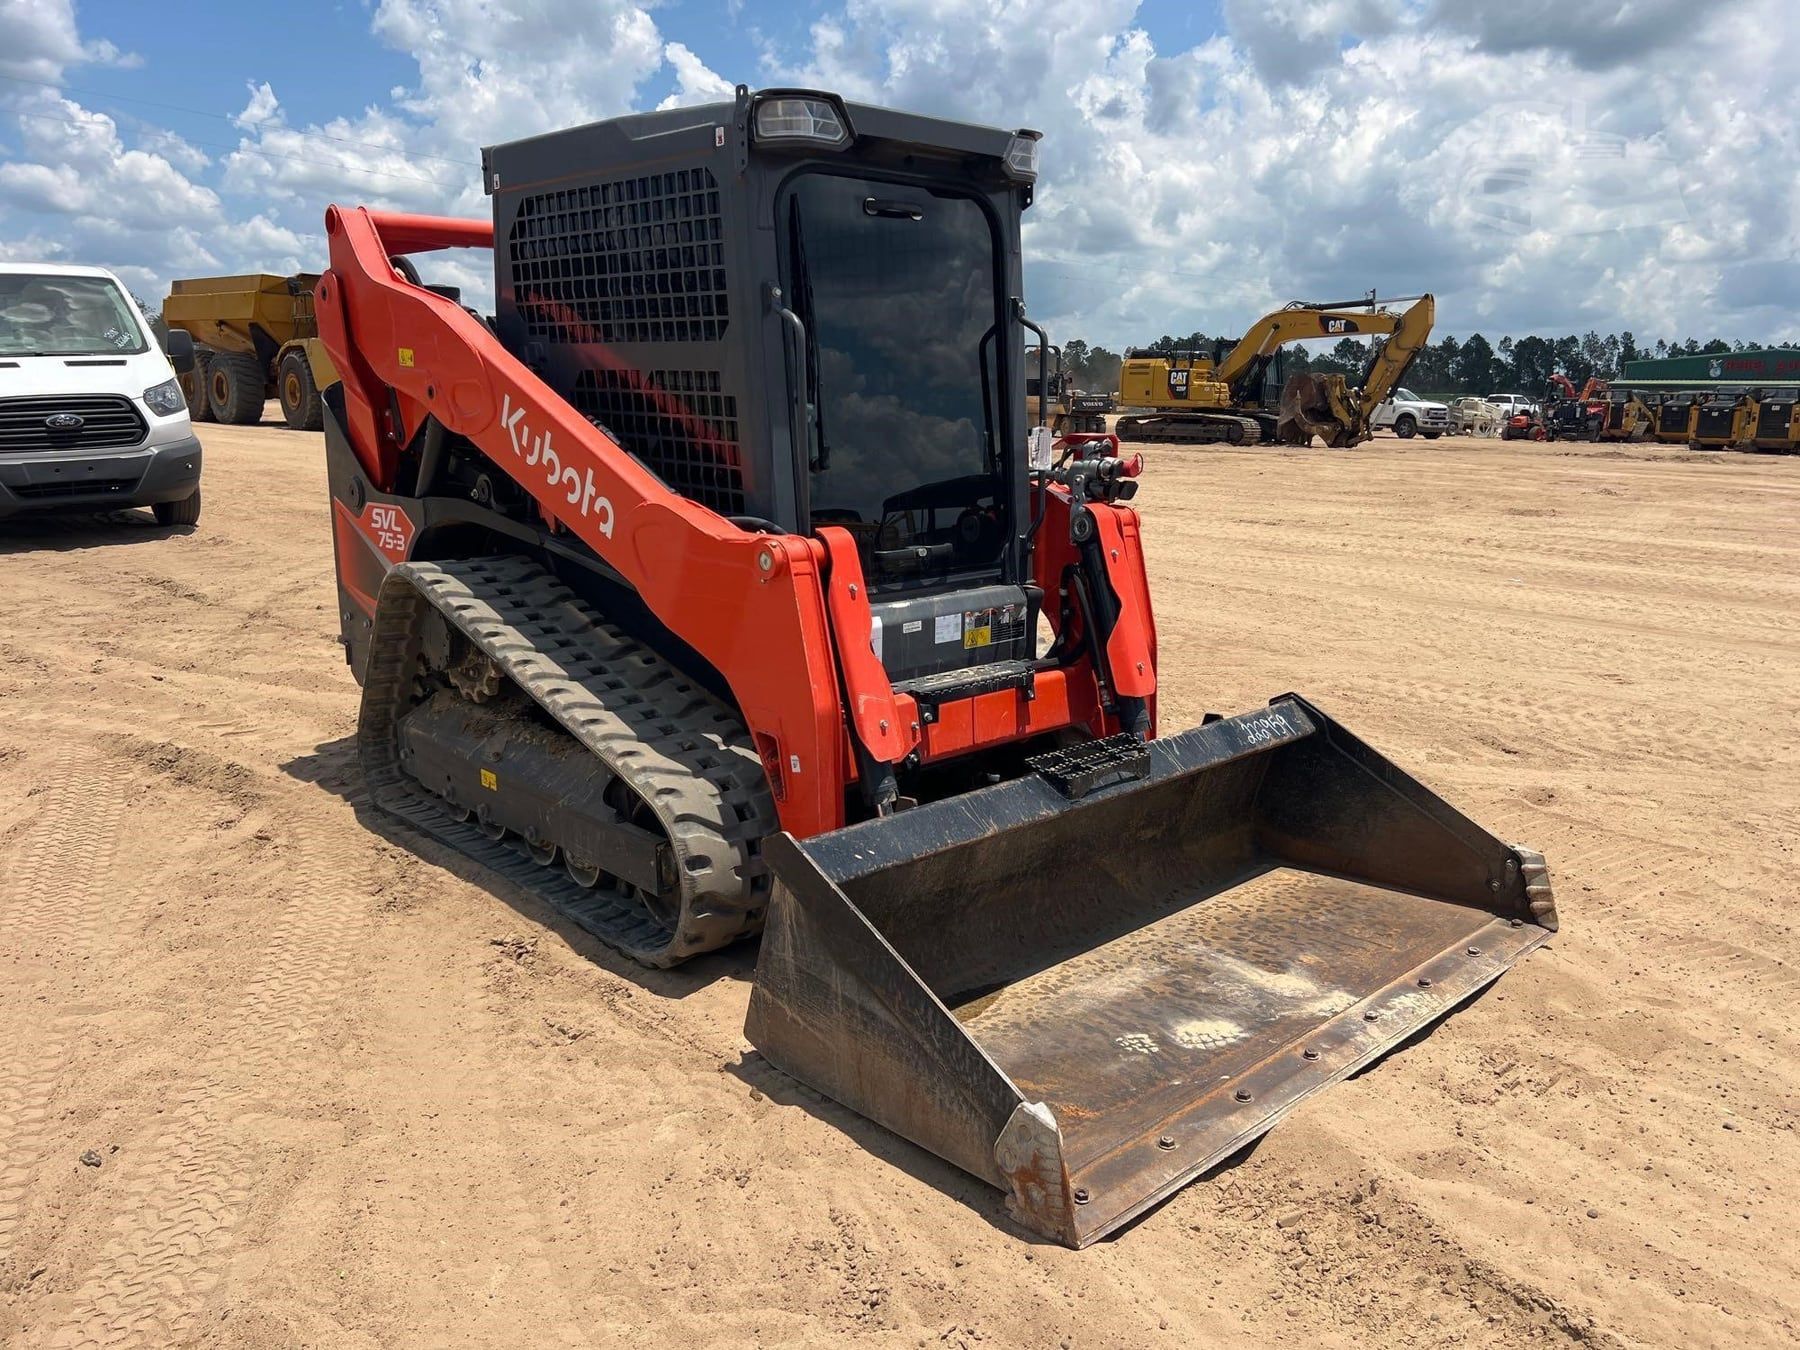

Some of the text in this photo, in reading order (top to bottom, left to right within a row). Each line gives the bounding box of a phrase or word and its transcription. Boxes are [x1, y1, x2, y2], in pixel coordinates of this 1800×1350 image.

[1328, 319, 1347, 333] CAT
[1170, 371, 1188, 385] CAT
[501, 393, 615, 540] Kubota
[371, 507, 402, 532] SVL
[377, 531, 405, 551] 75-3
